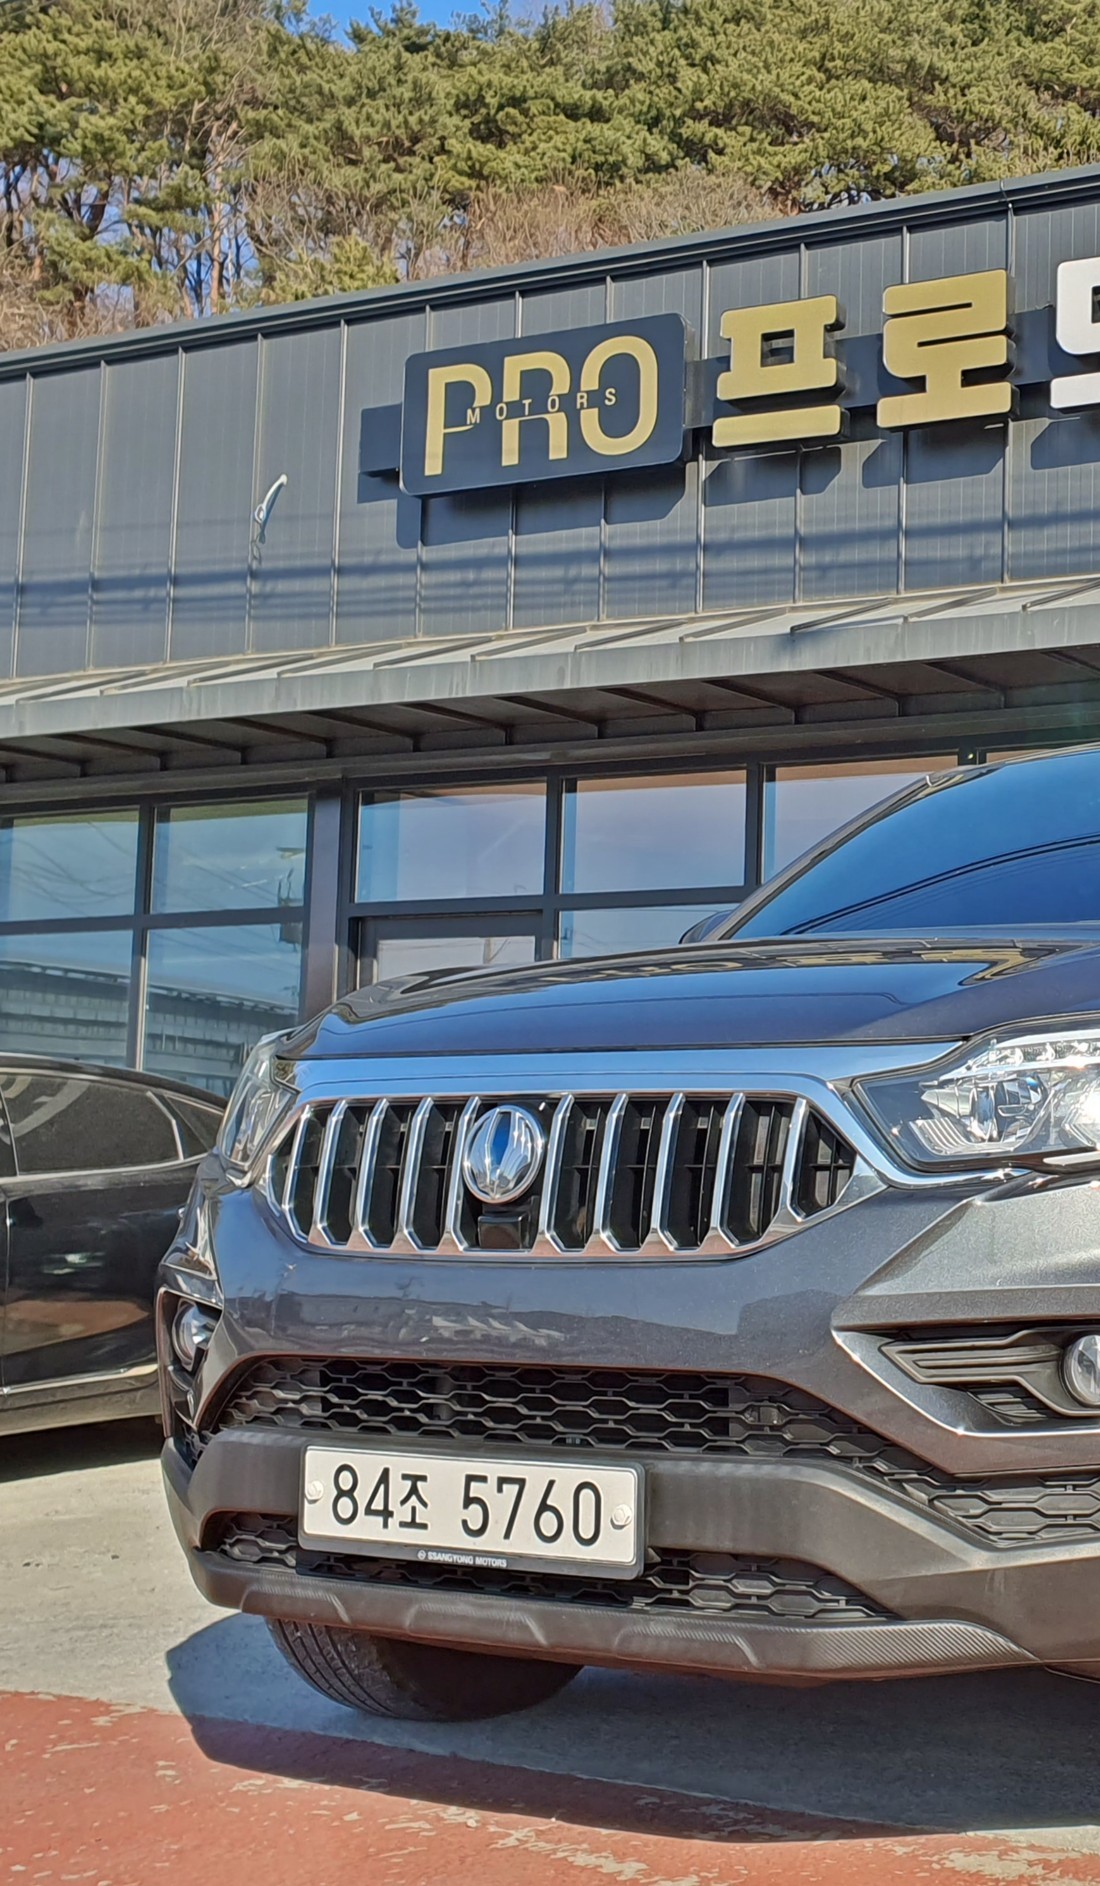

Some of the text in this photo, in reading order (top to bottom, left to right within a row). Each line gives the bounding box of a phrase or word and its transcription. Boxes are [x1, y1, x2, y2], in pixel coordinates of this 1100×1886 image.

[424, 335, 658, 476] PRO
[466, 387, 617, 424] MOTORS
[331, 1463, 602, 1547] 84조 5760
[427, 1551, 507, 1568] SSANGYONG MOTORS
